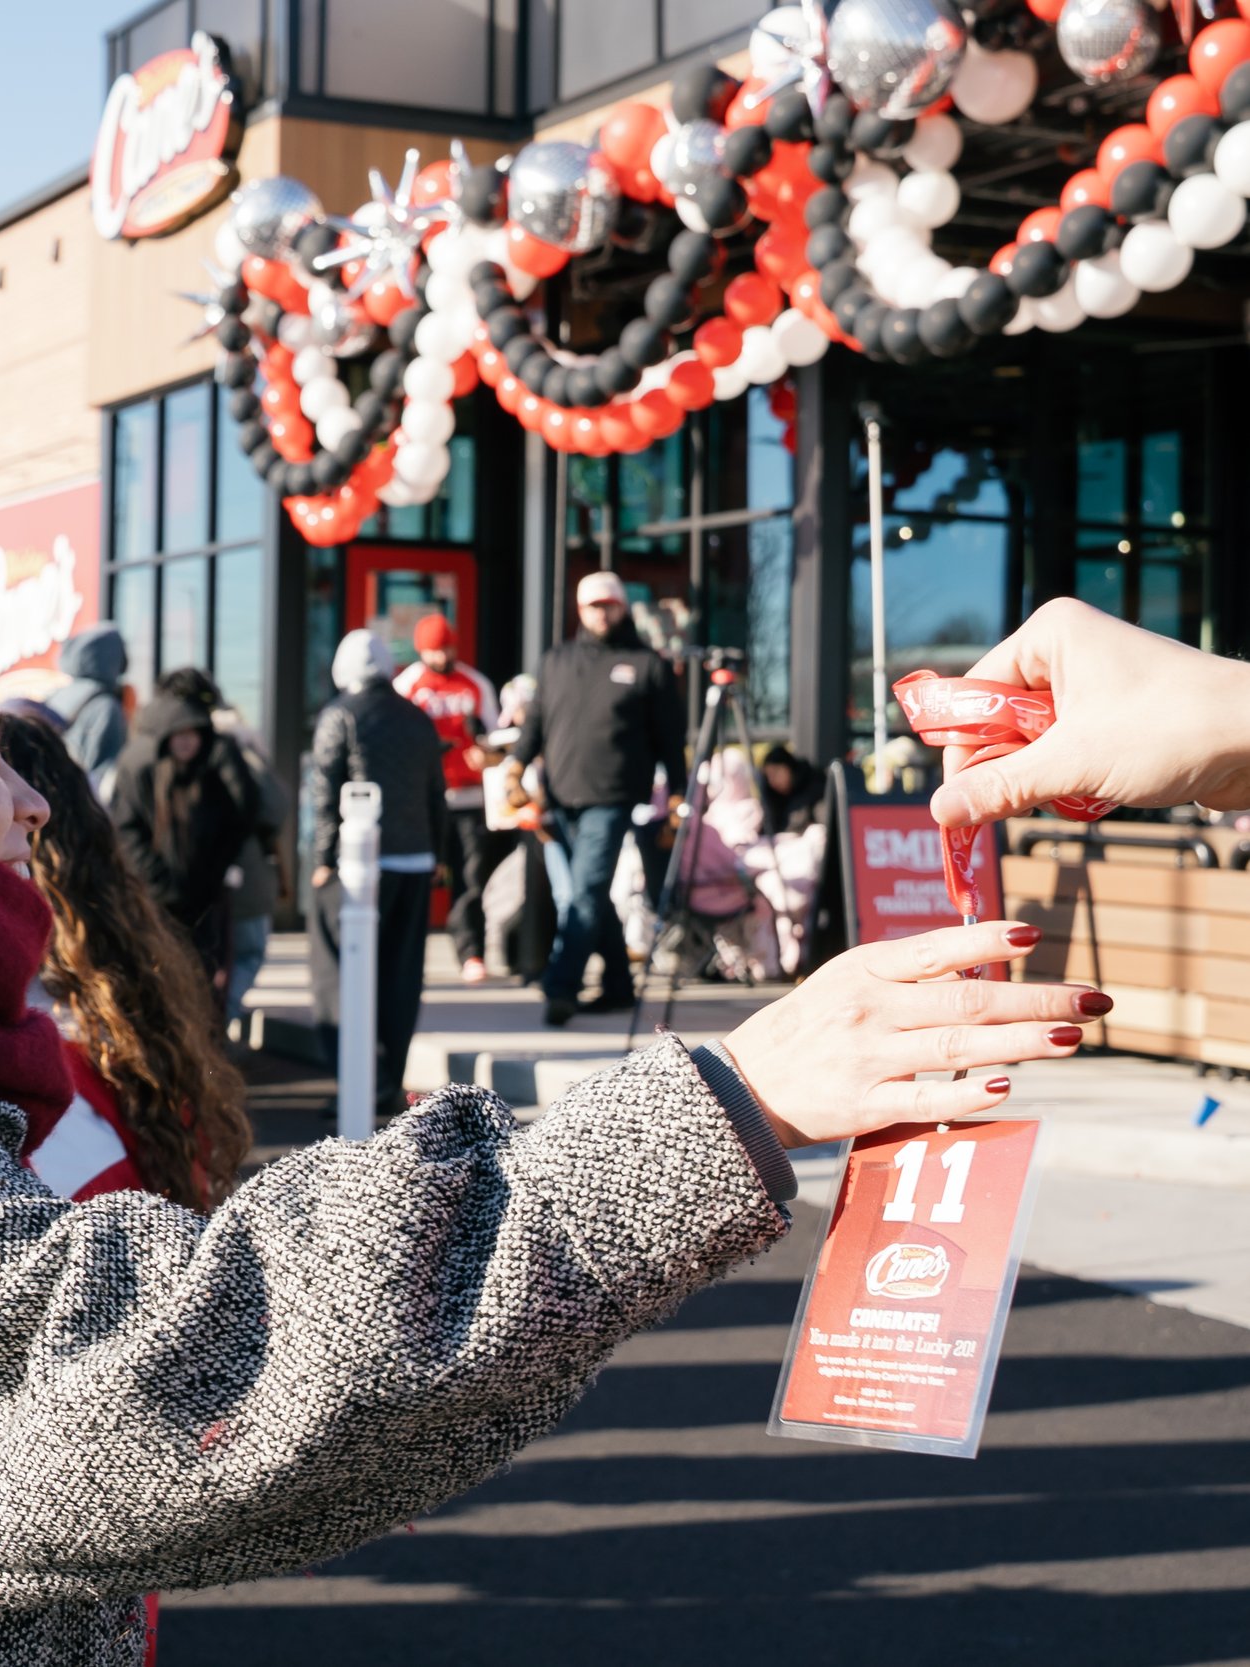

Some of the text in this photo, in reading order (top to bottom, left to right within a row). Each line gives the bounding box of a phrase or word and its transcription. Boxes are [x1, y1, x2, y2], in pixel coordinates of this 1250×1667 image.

[864, 828, 984, 869] SMI
[882, 1140, 977, 1223] 11
[850, 1308, 941, 1333] CONGRATS!
[809, 1327, 977, 1358] You made it into the Lucky 20!
